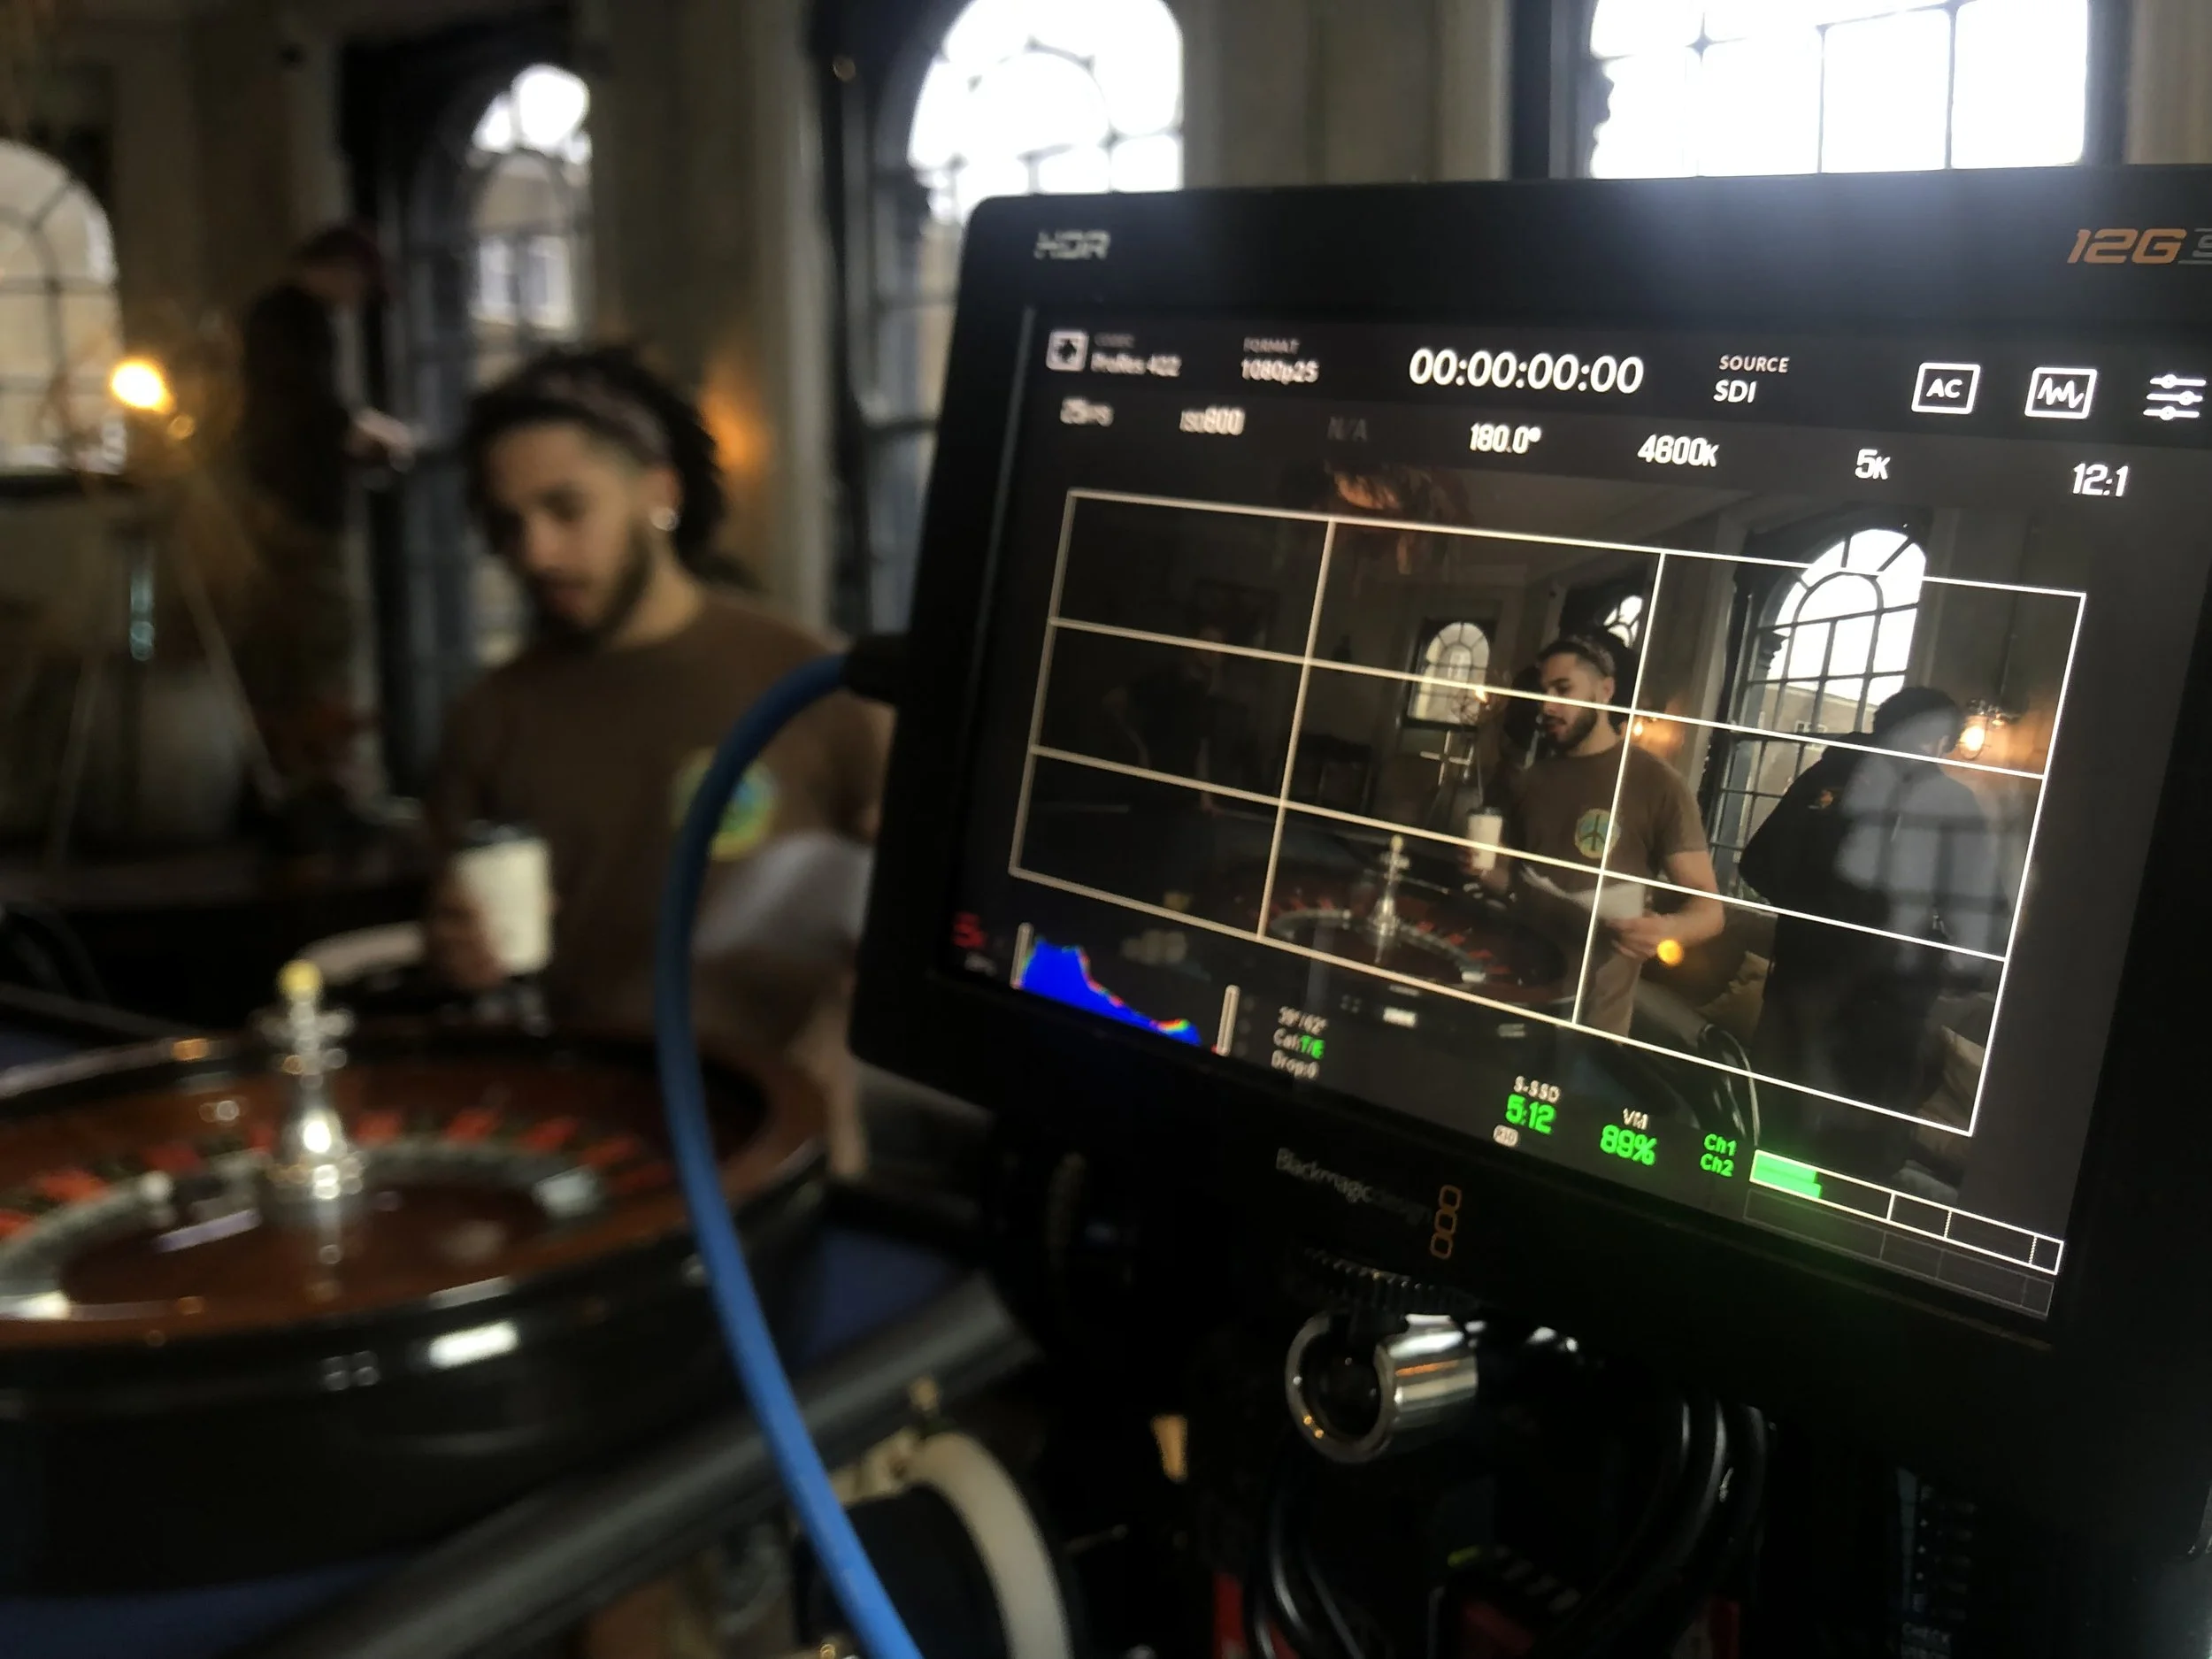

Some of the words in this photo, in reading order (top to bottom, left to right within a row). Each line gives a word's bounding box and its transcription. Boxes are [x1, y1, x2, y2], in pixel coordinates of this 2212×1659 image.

[2066, 227, 2188, 265] 12G
[1409, 347, 1646, 395] 00:00:00:00
[1718, 354, 1790, 374] SOURCE
[1712, 378, 1758, 404] SDI
[2070, 462, 2130, 497] 12:1
[1600, 1123, 1658, 1166] 89%
[1702, 1133, 1738, 1157] Ch1
[1699, 1152, 1735, 1178] Ch2
